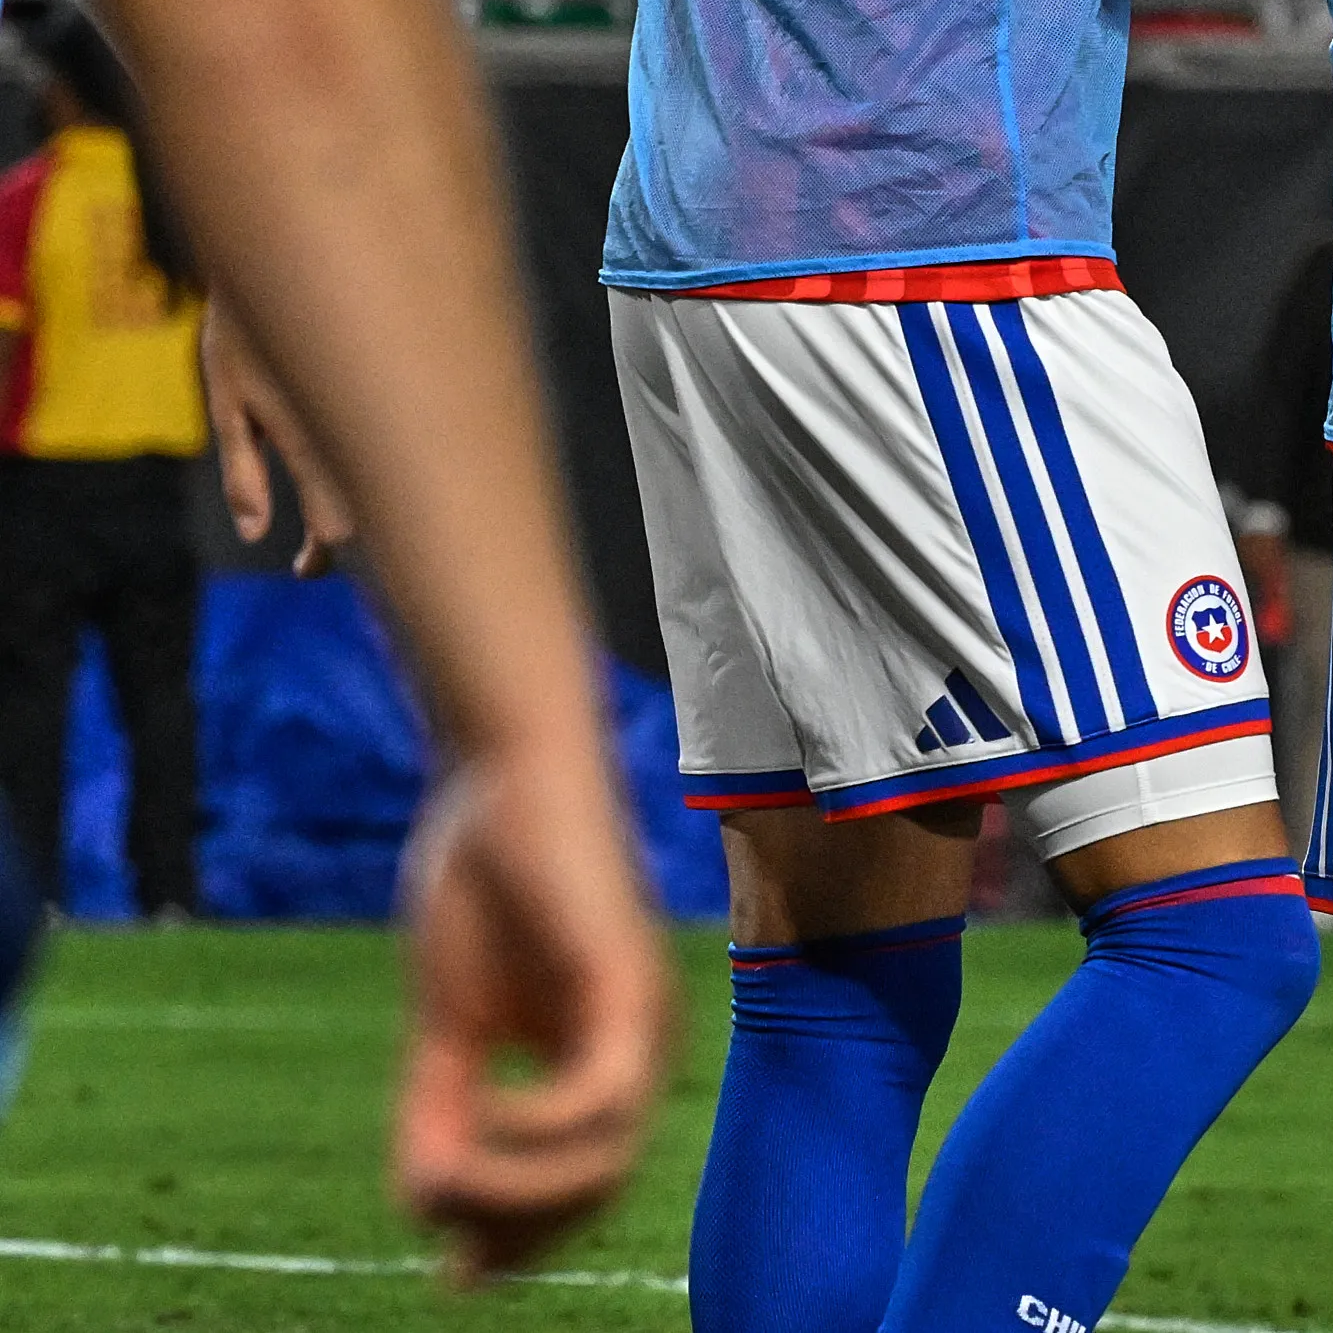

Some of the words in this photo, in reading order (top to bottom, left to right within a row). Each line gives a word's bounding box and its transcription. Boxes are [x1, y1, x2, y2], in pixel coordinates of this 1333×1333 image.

[1174, 584, 1205, 637] FEDERACION
[1209, 583, 1220, 596] DE
[1222, 589, 1242, 625] FUTBOL
[1205, 661, 1218, 674] DE
